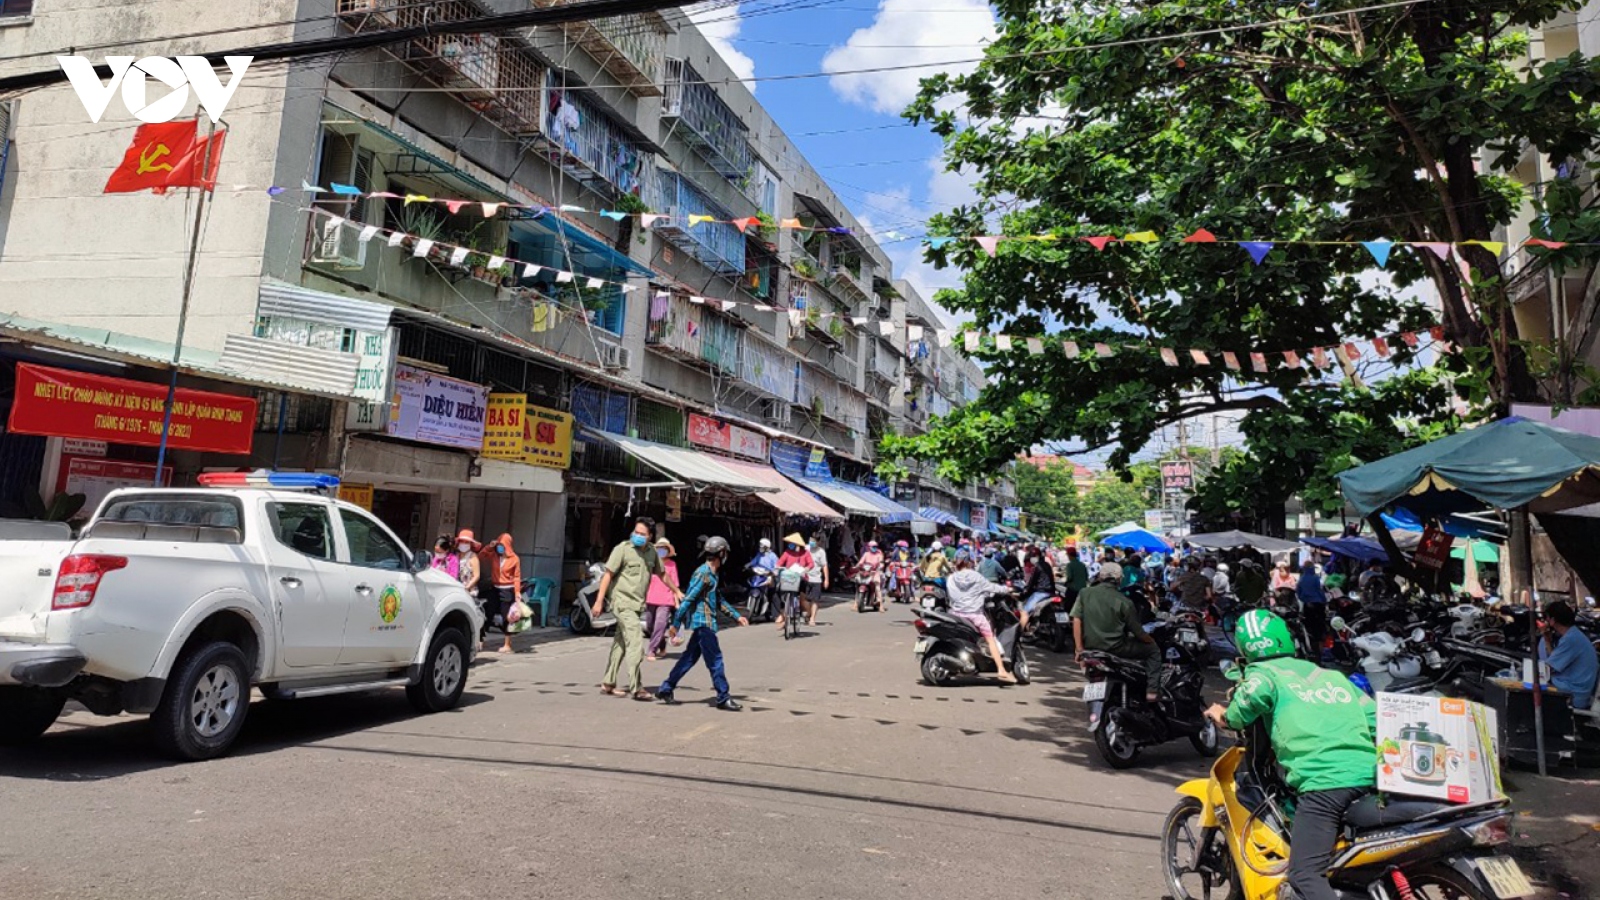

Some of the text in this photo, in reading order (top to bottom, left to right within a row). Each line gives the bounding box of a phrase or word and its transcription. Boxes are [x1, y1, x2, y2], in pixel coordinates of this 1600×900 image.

[423, 393, 485, 423] DIỆU HIỀN
[488, 408, 505, 427] BA
[507, 408, 520, 427] SI
[535, 421, 557, 445] SI
[1245, 636, 1274, 652] Grab
[1288, 681, 1351, 704] Grab
